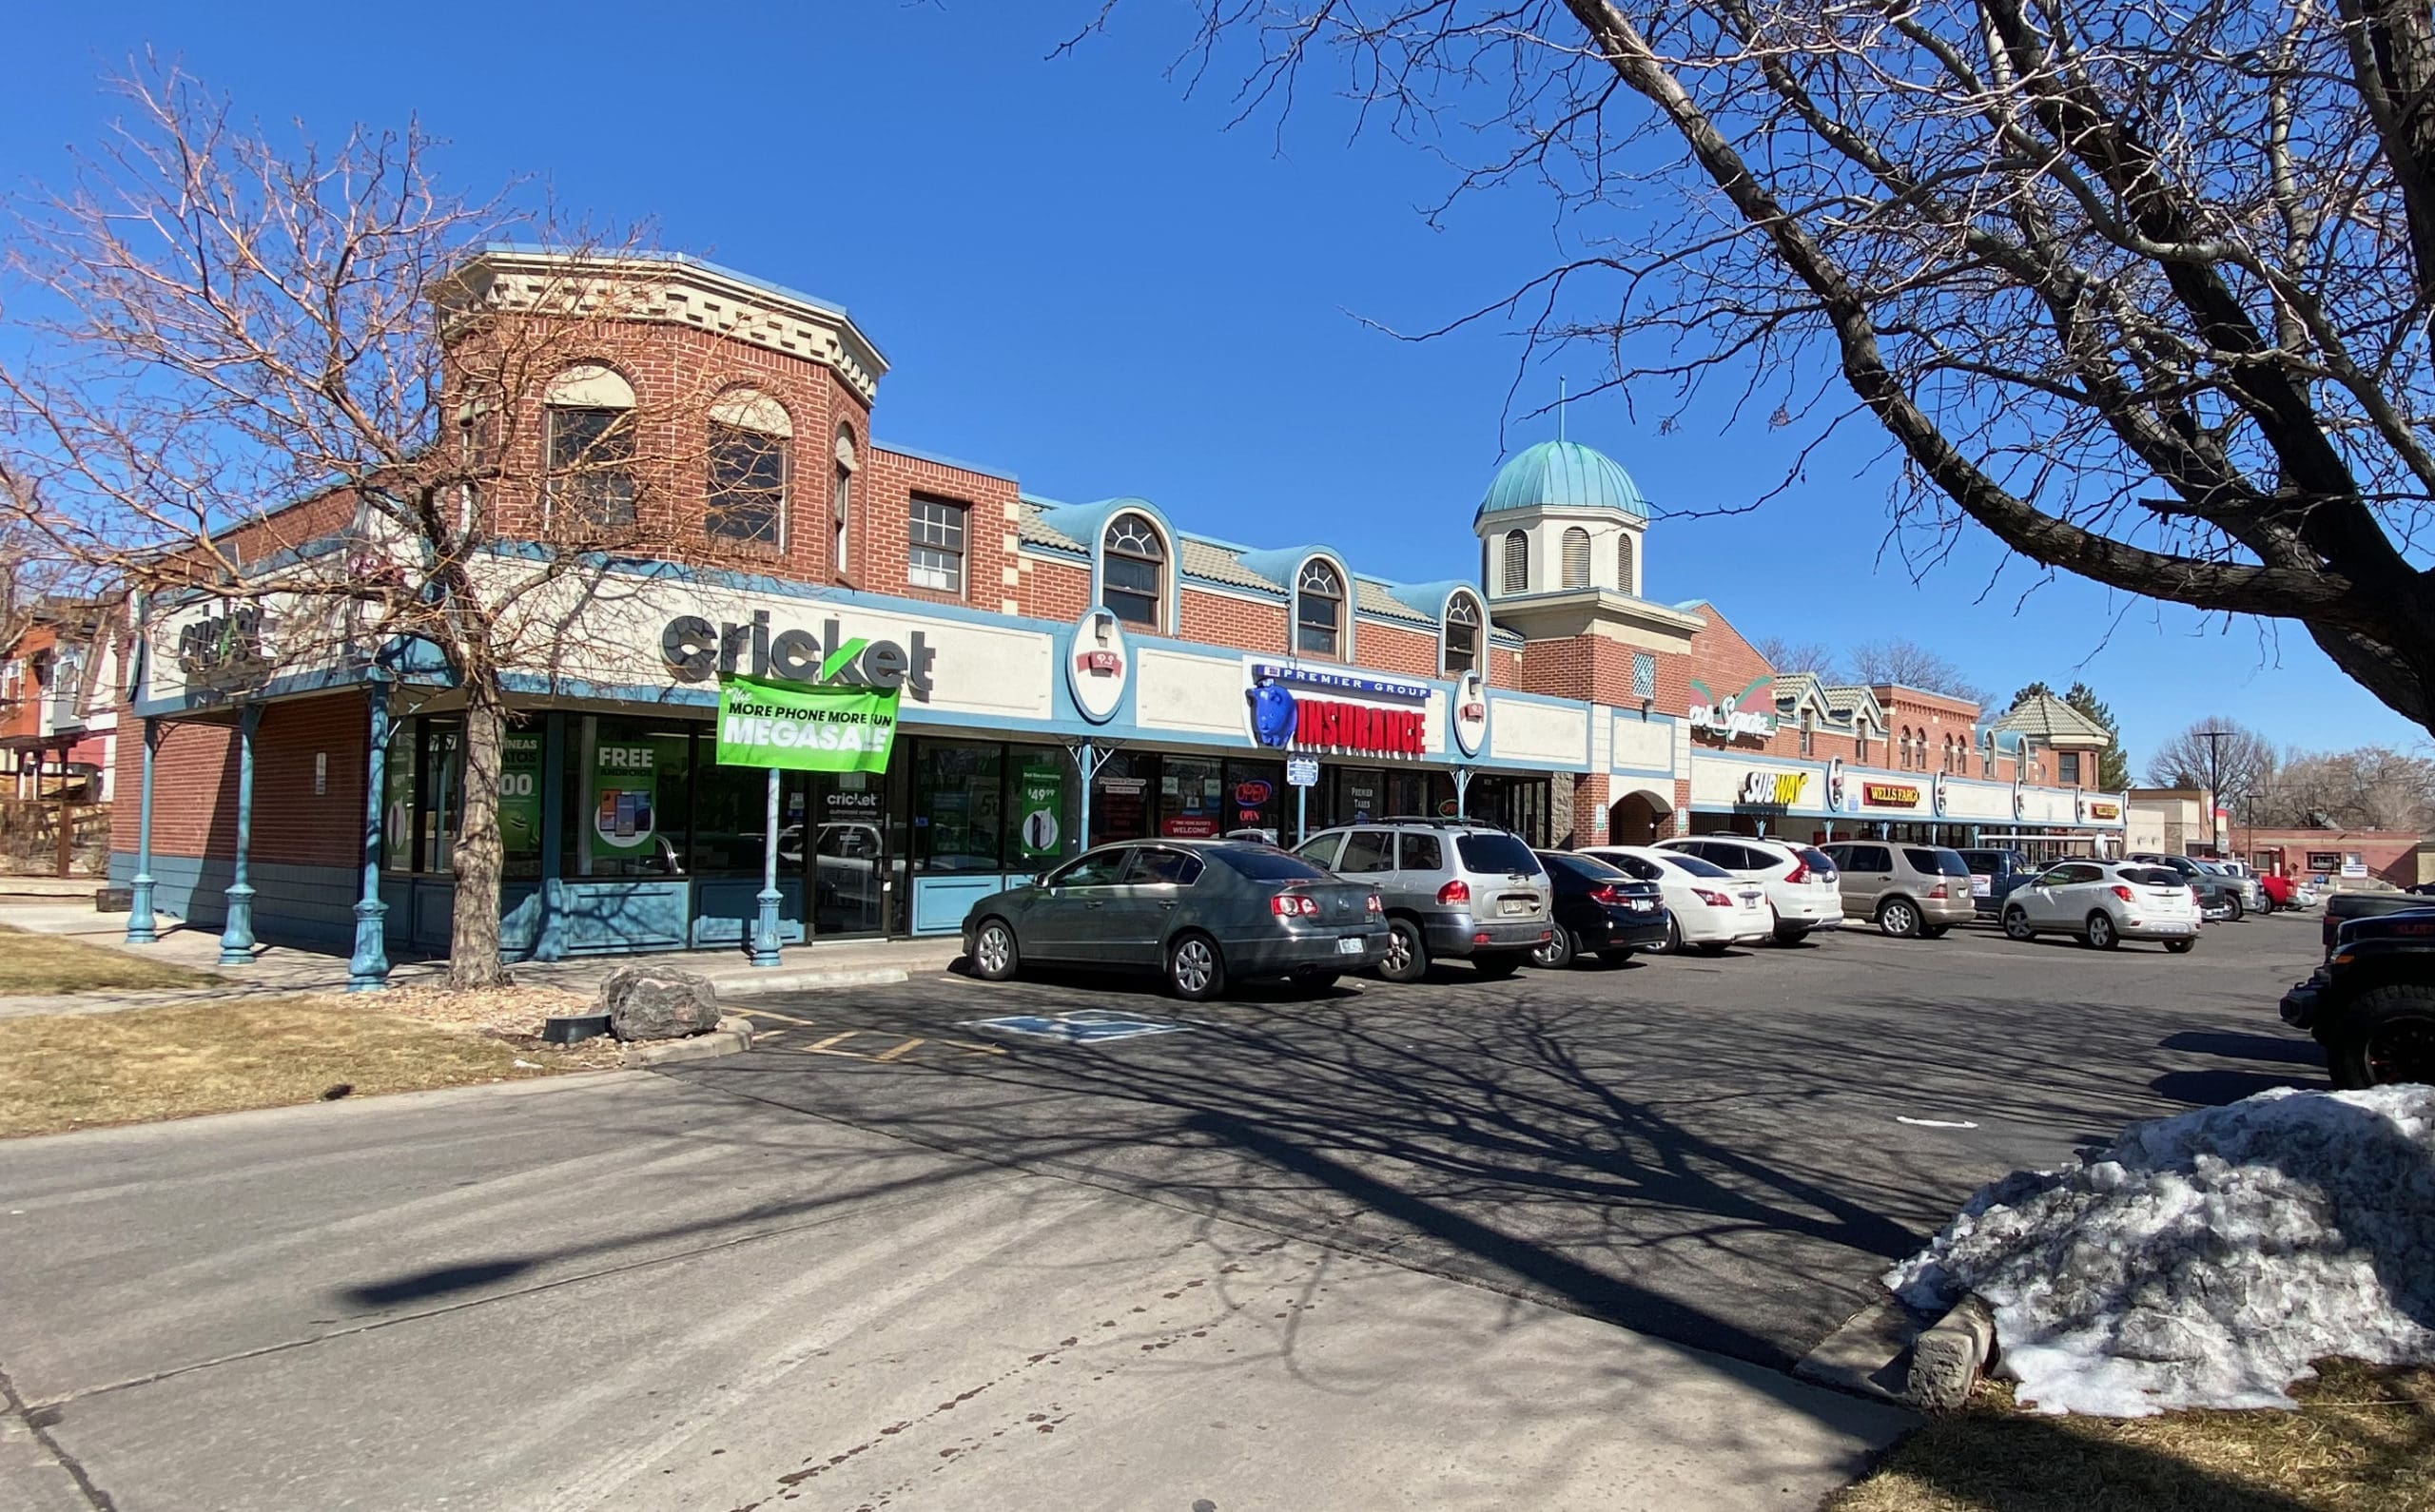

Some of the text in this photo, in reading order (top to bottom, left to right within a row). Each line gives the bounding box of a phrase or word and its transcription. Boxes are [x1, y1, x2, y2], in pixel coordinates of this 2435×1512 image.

[662, 610, 936, 693] cricket
[1283, 669, 1362, 688] PREMIER
[1374, 683, 1428, 697] GROUP
[726, 687, 753, 704] The
[729, 702, 772, 717] MORE
[774, 707, 825, 722] PHONE
[828, 711, 867, 725] MORE
[723, 716, 890, 753] MEGASALE
[1296, 699, 1426, 754] INSURANCE
[598, 746, 654, 767] FREE
[1236, 783, 1268, 802] OPEN
[1744, 771, 1808, 804] SUBWAY
[1871, 786, 1920, 803] WELLS FARGO
[827, 792, 877, 806] cricket
[1239, 810, 1260, 822] OPEN
